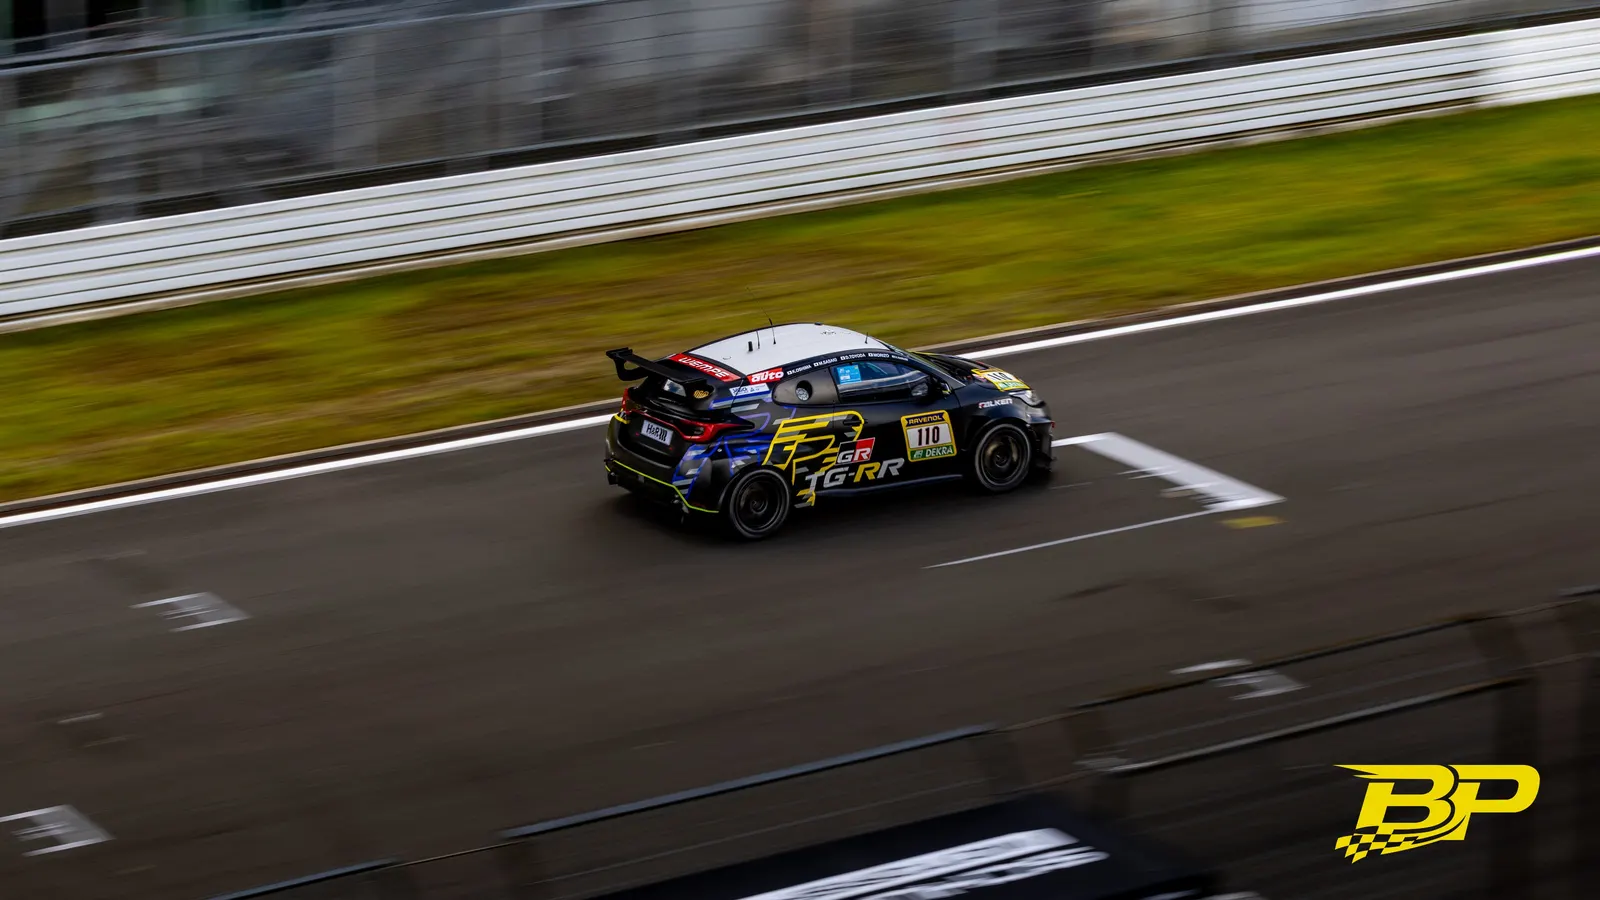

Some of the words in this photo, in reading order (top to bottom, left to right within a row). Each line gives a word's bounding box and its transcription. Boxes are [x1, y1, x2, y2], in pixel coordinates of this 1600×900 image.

[678, 356, 730, 378] WEMPE
[751, 370, 784, 383] auto
[908, 414, 943, 425] RAVENOL
[917, 425, 940, 447] 110
[836, 447, 871, 464] GR
[925, 445, 954, 458] DEKRA
[804, 457, 905, 496] TG-RR
